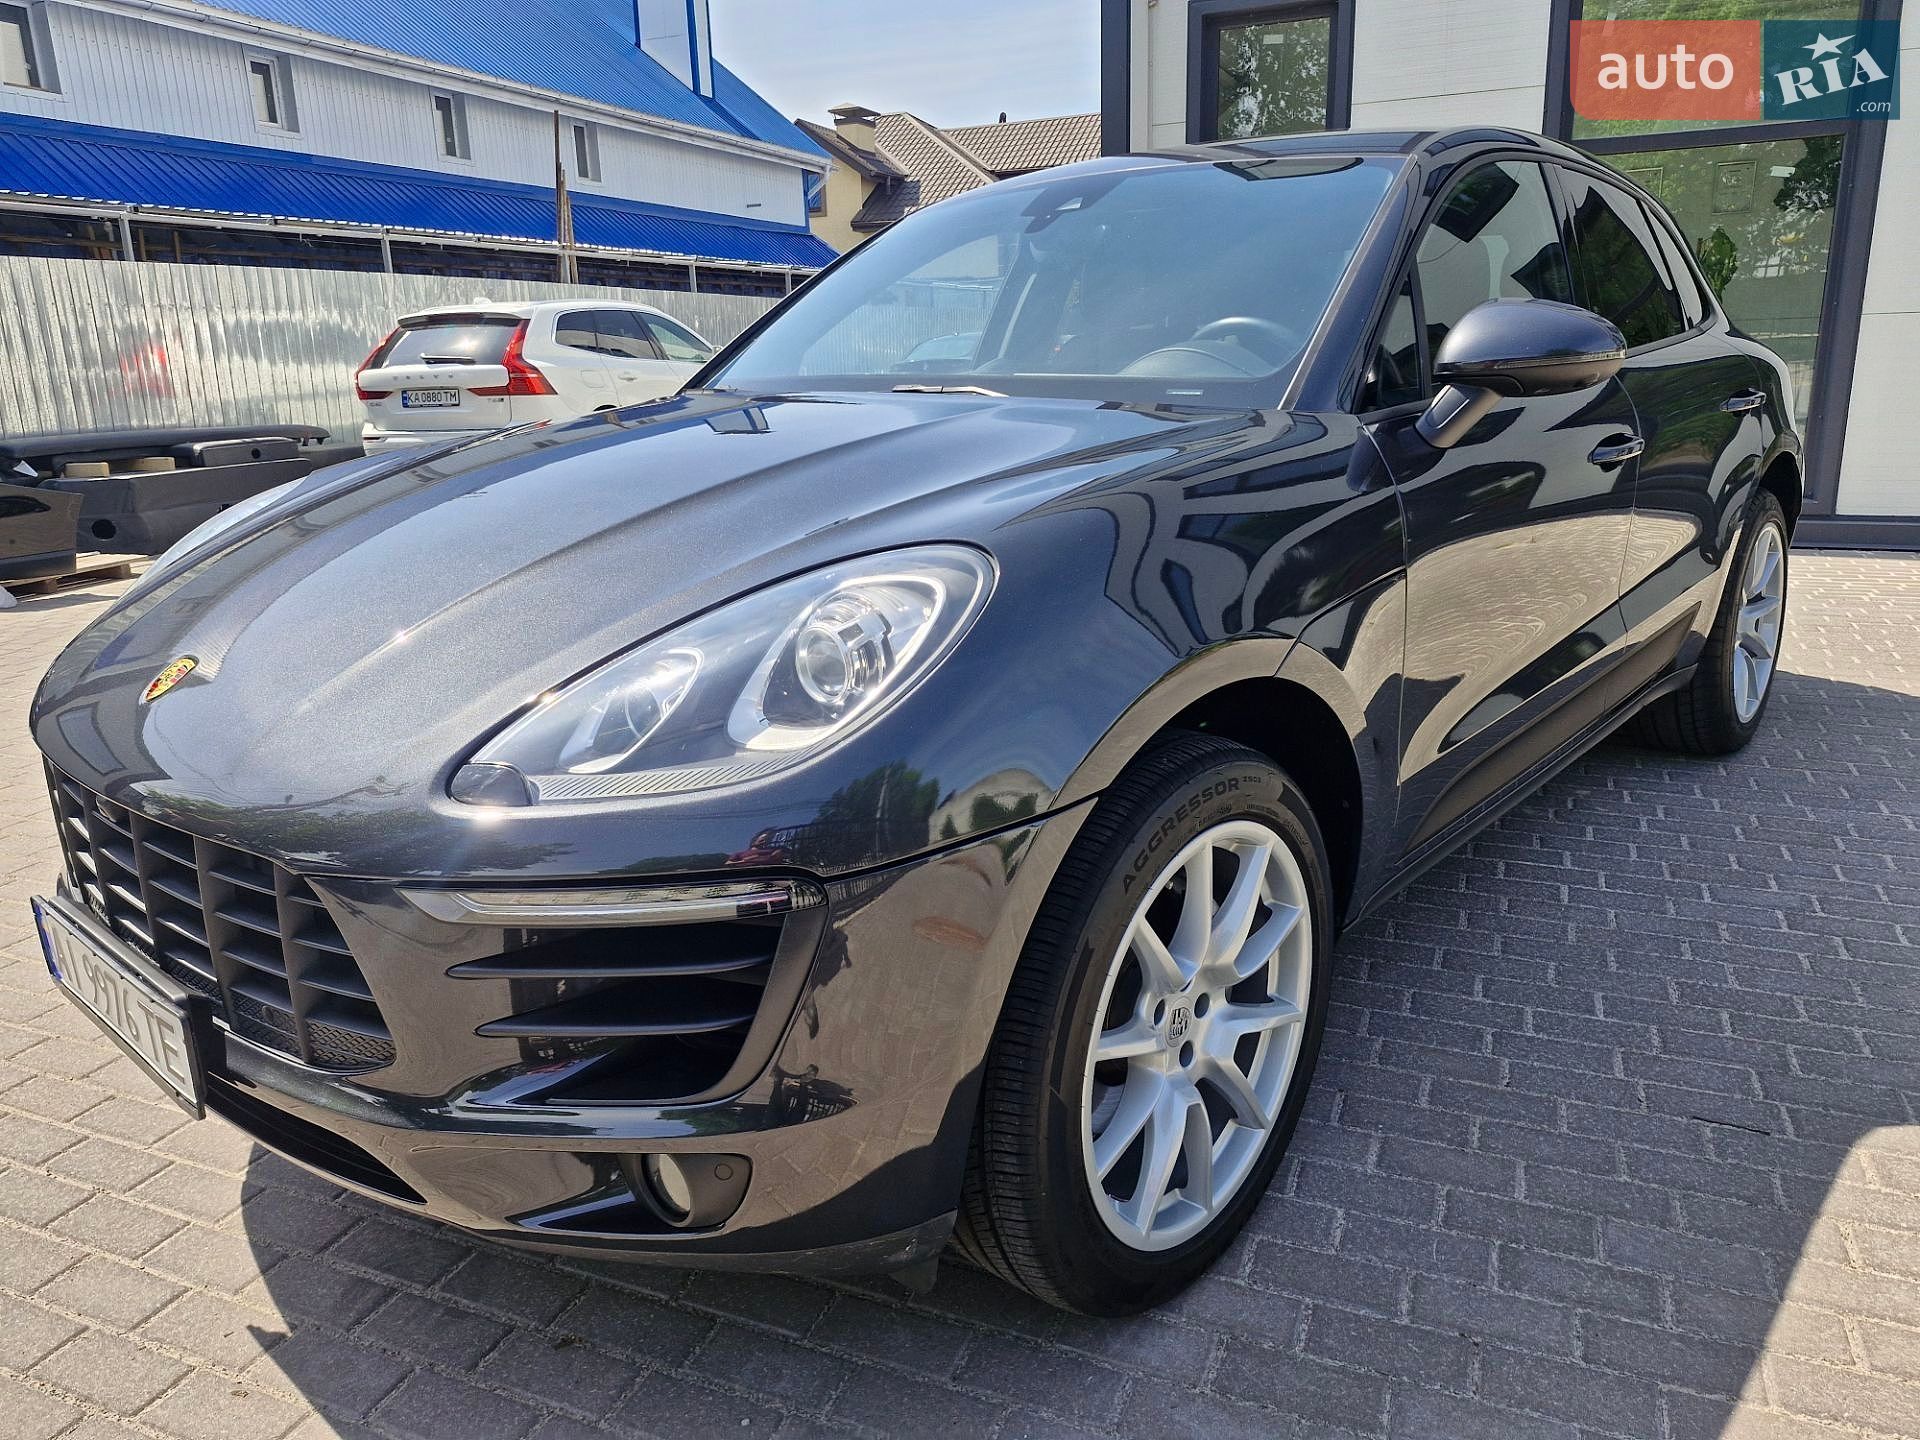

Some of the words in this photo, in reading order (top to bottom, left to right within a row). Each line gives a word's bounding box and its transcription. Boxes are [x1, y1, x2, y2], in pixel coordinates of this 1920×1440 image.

[408, 392, 420, 403] KA
[421, 391, 442, 403] 0880
[444, 391, 457, 402] TM
[1122, 776, 1240, 895] AGGRESSOR
[82, 953, 140, 1042] 9976
[137, 999, 185, 1085] TE
